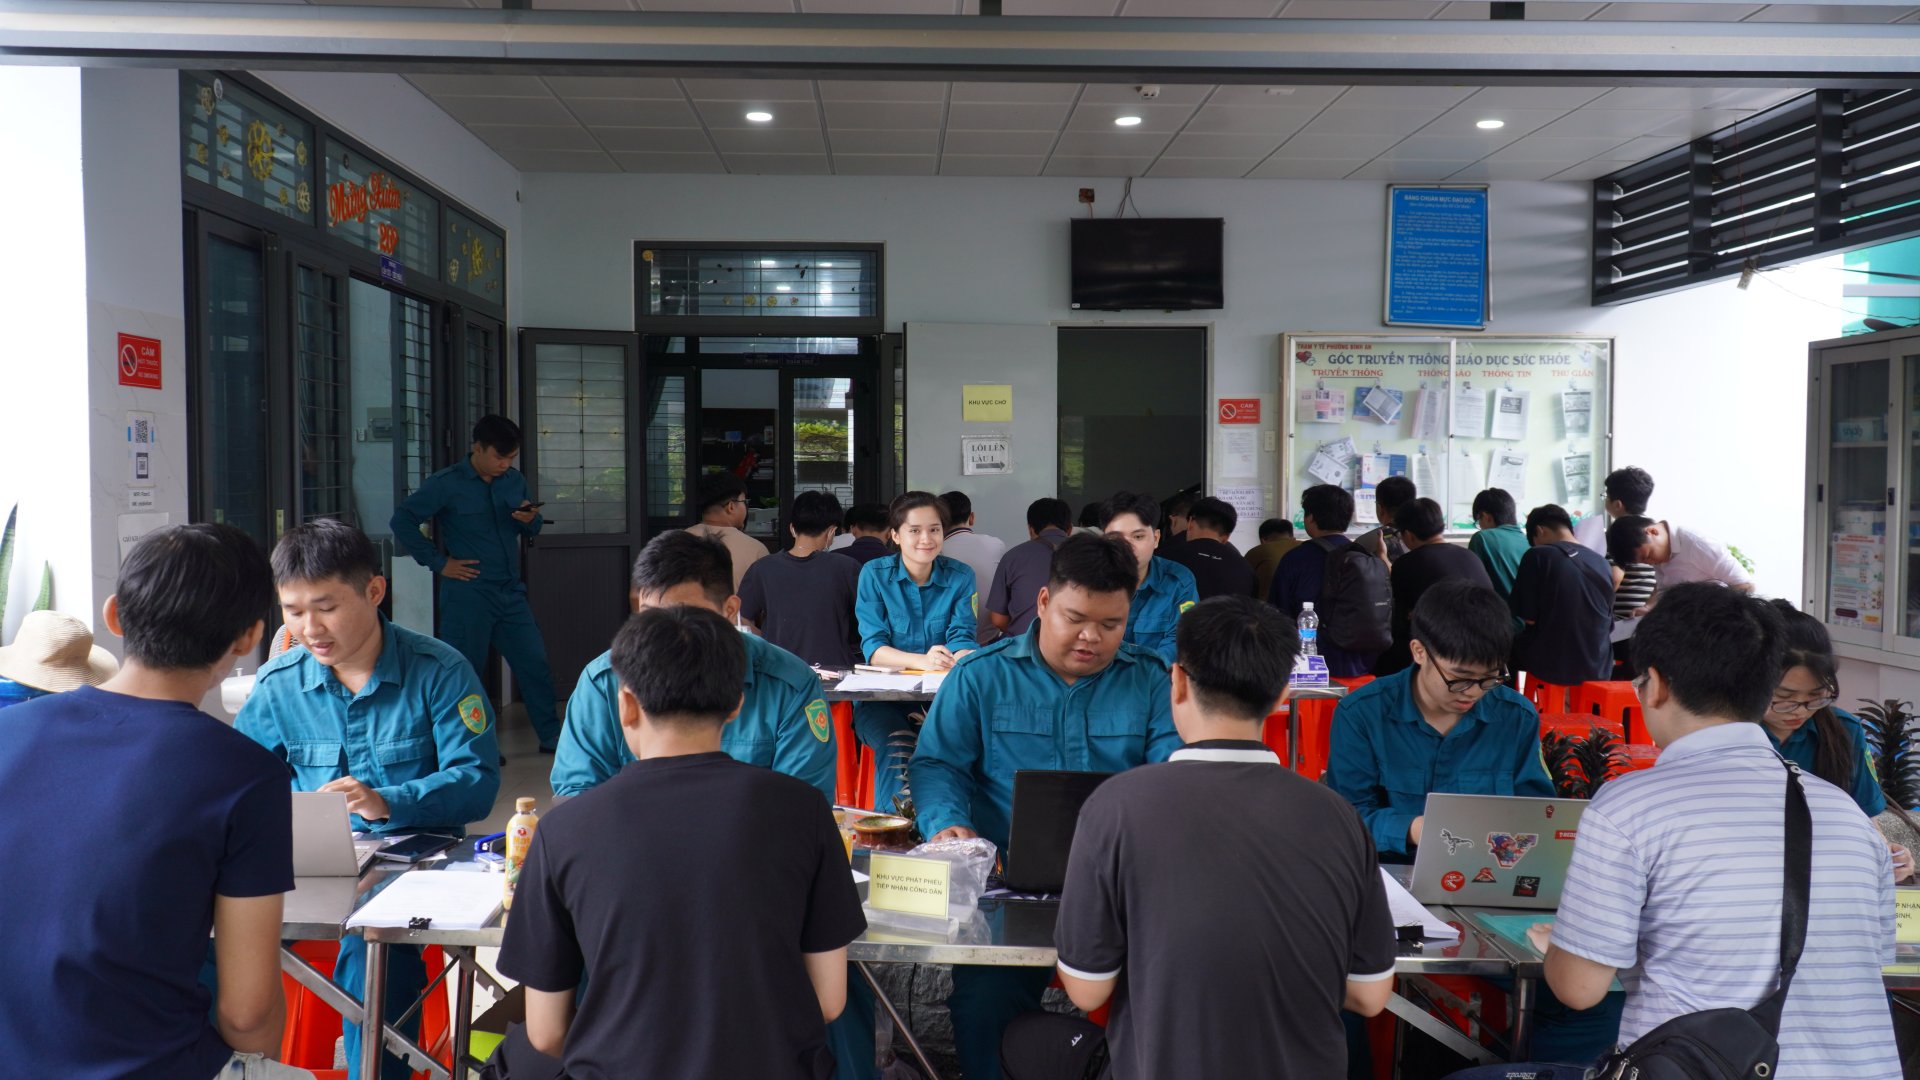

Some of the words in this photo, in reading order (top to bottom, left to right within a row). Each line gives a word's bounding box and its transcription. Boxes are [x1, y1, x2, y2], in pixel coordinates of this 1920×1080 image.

[1328, 353, 1354, 365] GÓC
[1408, 351, 1450, 365] THÔNG
[1455, 353, 1482, 365] GIÁO
[1486, 355, 1509, 368] DỤC
[1512, 353, 1536, 365] SỨC
[1539, 351, 1571, 365] KHỎE
[1350, 367, 1384, 377] THÔNG
[1481, 369, 1514, 378] THÔNG
[891, 874, 904, 882] VỰC
[905, 875, 922, 883] PHÁT
[924, 878, 943, 886] PHIẾU
[891, 883, 908, 891] NHẬN
[909, 886, 928, 894] CÔNG
[929, 887, 943, 895] DÂN
